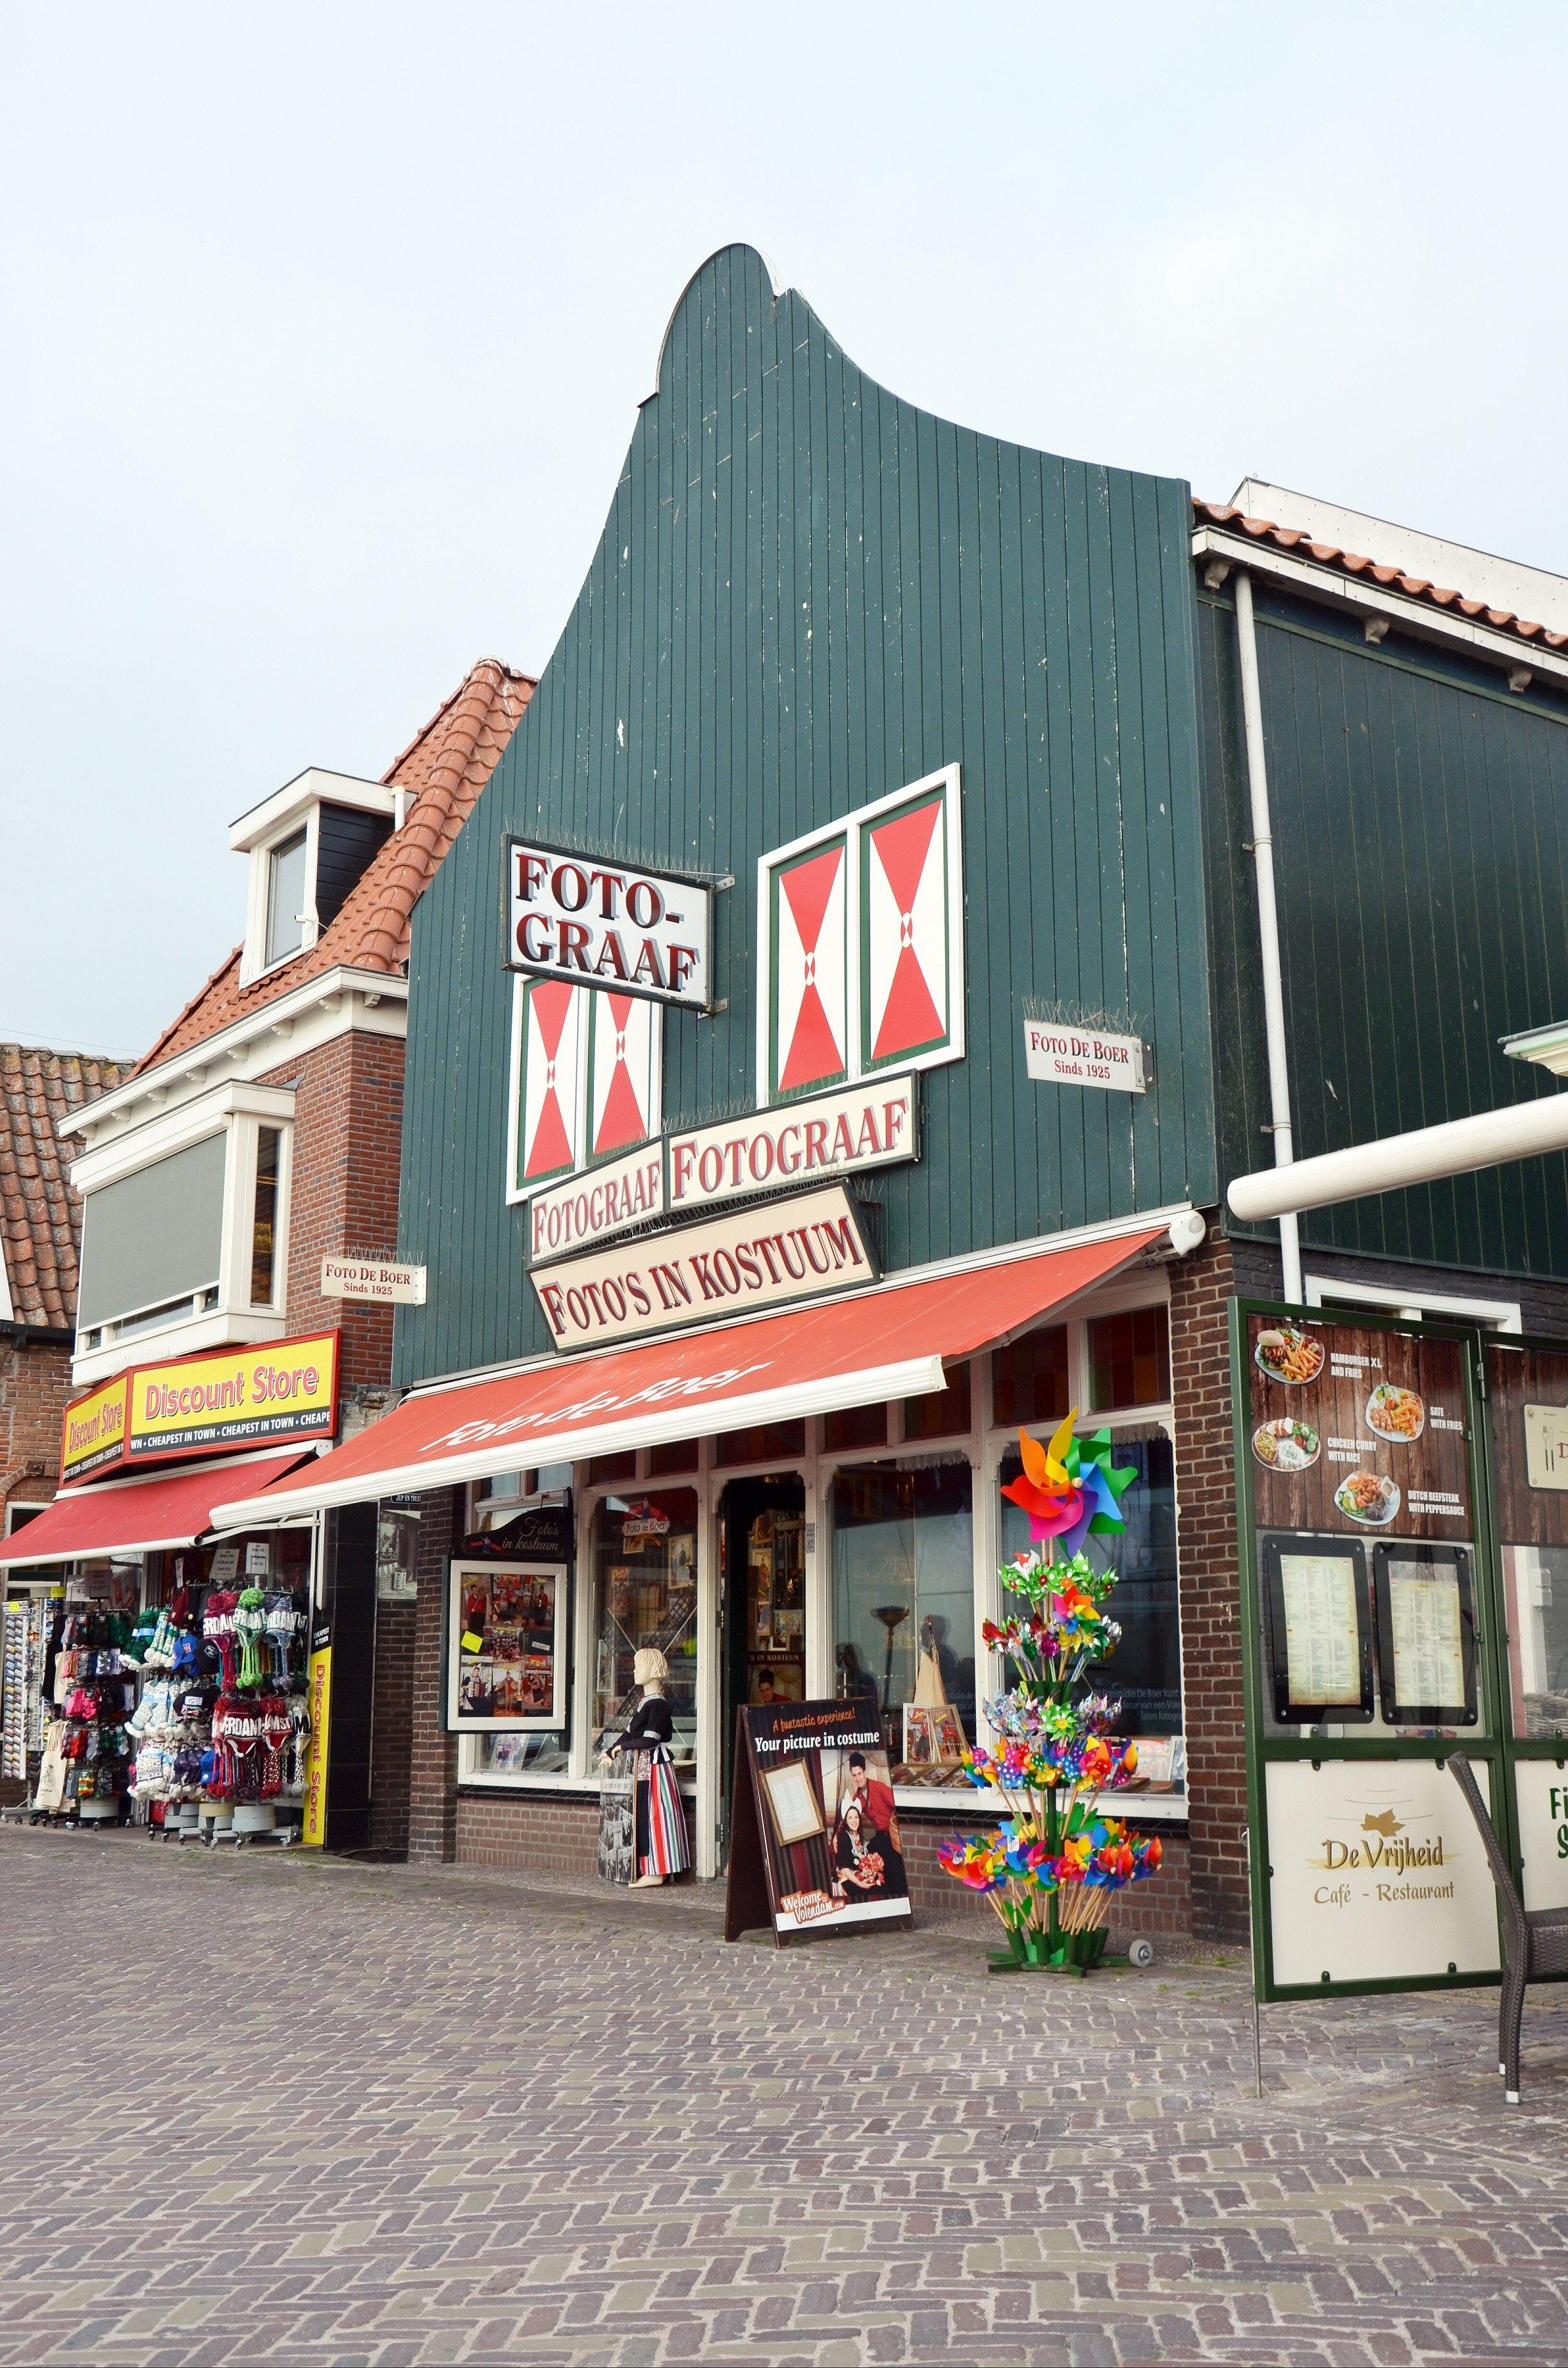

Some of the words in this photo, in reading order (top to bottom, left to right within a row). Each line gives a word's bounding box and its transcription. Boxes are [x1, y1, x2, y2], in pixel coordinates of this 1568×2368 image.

[516, 851, 683, 928] FOTO-
[516, 912, 700, 992] GRAAF
[1030, 1032, 1067, 1055] FOTO
[1070, 1037, 1090, 1057] DE
[1093, 1040, 1129, 1064] BOER
[1054, 1060, 1082, 1075] Sinds
[1086, 1065, 1111, 1079] 1925
[671, 1096, 909, 1201] FOTOGRAAF
[533, 1160, 661, 1254] FOTOGRAAF
[325, 1264, 356, 1279] FOTO
[360, 1267, 376, 1281] DE
[380, 1270, 411, 1285] BOER
[539, 1271, 651, 1335] FOTO'S
[648, 1260, 692, 1310] IN
[689, 1216, 863, 1300] KOSTUUM
[344, 1283, 368, 1293] Sinds
[372, 1285, 392, 1295] 1925
[1330, 1353, 1369, 1367] HAMBURGER
[1371, 1358, 1382, 1368] XL
[1331, 1366, 1344, 1376] AND
[1345, 1367, 1362, 1378] FRIES
[145, 1372, 243, 1419] Discount
[252, 1366, 319, 1402] Store
[1430, 1406, 1444, 1417] SATE
[69, 1408, 101, 1453] Discount
[101, 1402, 122, 1436] Store
[147, 1433, 183, 1447] CHEAPEST
[184, 1431, 193, 1442] IN
[193, 1428, 215, 1442] TOWN
[222, 1421, 259, 1436] CHEAPEST
[261, 1420, 269, 1430] IN
[271, 1417, 294, 1429] TOWN
[1430, 1418, 1446, 1429] WITH
[1447, 1420, 1462, 1431] FRIES
[1328, 1437, 1355, 1449] CHICKEN
[1356, 1440, 1376, 1451] CURRY
[1328, 1451, 1345, 1461] WITH
[1346, 1452, 1361, 1463] RICE
[1408, 1490, 1428, 1501] DUTCH
[1428, 1492, 1459, 1503] BEEFSTEAK
[1409, 1502, 1425, 1513] WITH
[1425, 1504, 1465, 1516] PEPPERSAUCE
[519, 1517, 559, 1536] Foto's
[626, 1524, 640, 1533] Foto
[650, 1522, 666, 1531] Boer
[502, 1538, 512, 1549] in
[516, 1536, 559, 1550] kostuum
[314, 1627, 329, 1639] CHEAPEST
[1138, 1689, 1146, 1698] De
[1148, 1689, 1162, 1698] Boer
[1164, 1689, 1178, 1698] kunt
[313, 1665, 325, 1763] Discount
[773, 1720, 779, 1732] A
[781, 1714, 815, 1732] funtastic
[817, 1707, 856, 1725] experience!
[1141, 1712, 1157, 1720] laten
[755, 1737, 781, 1752] Your
[783, 1735, 821, 1754] picture
[823, 1732, 835, 1747] in
[837, 1732, 879, 1745] costume
[309, 1771, 320, 1833] Store
[1321, 1839, 1360, 1870] De
[1361, 1836, 1443, 1876] Vrijheid
[783, 1892, 822, 1911] Welcome
[1314, 1884, 1352, 1909] Café
[1376, 1882, 1455, 1902] Restaurant
[795, 1900, 845, 1923] Volendam.com
